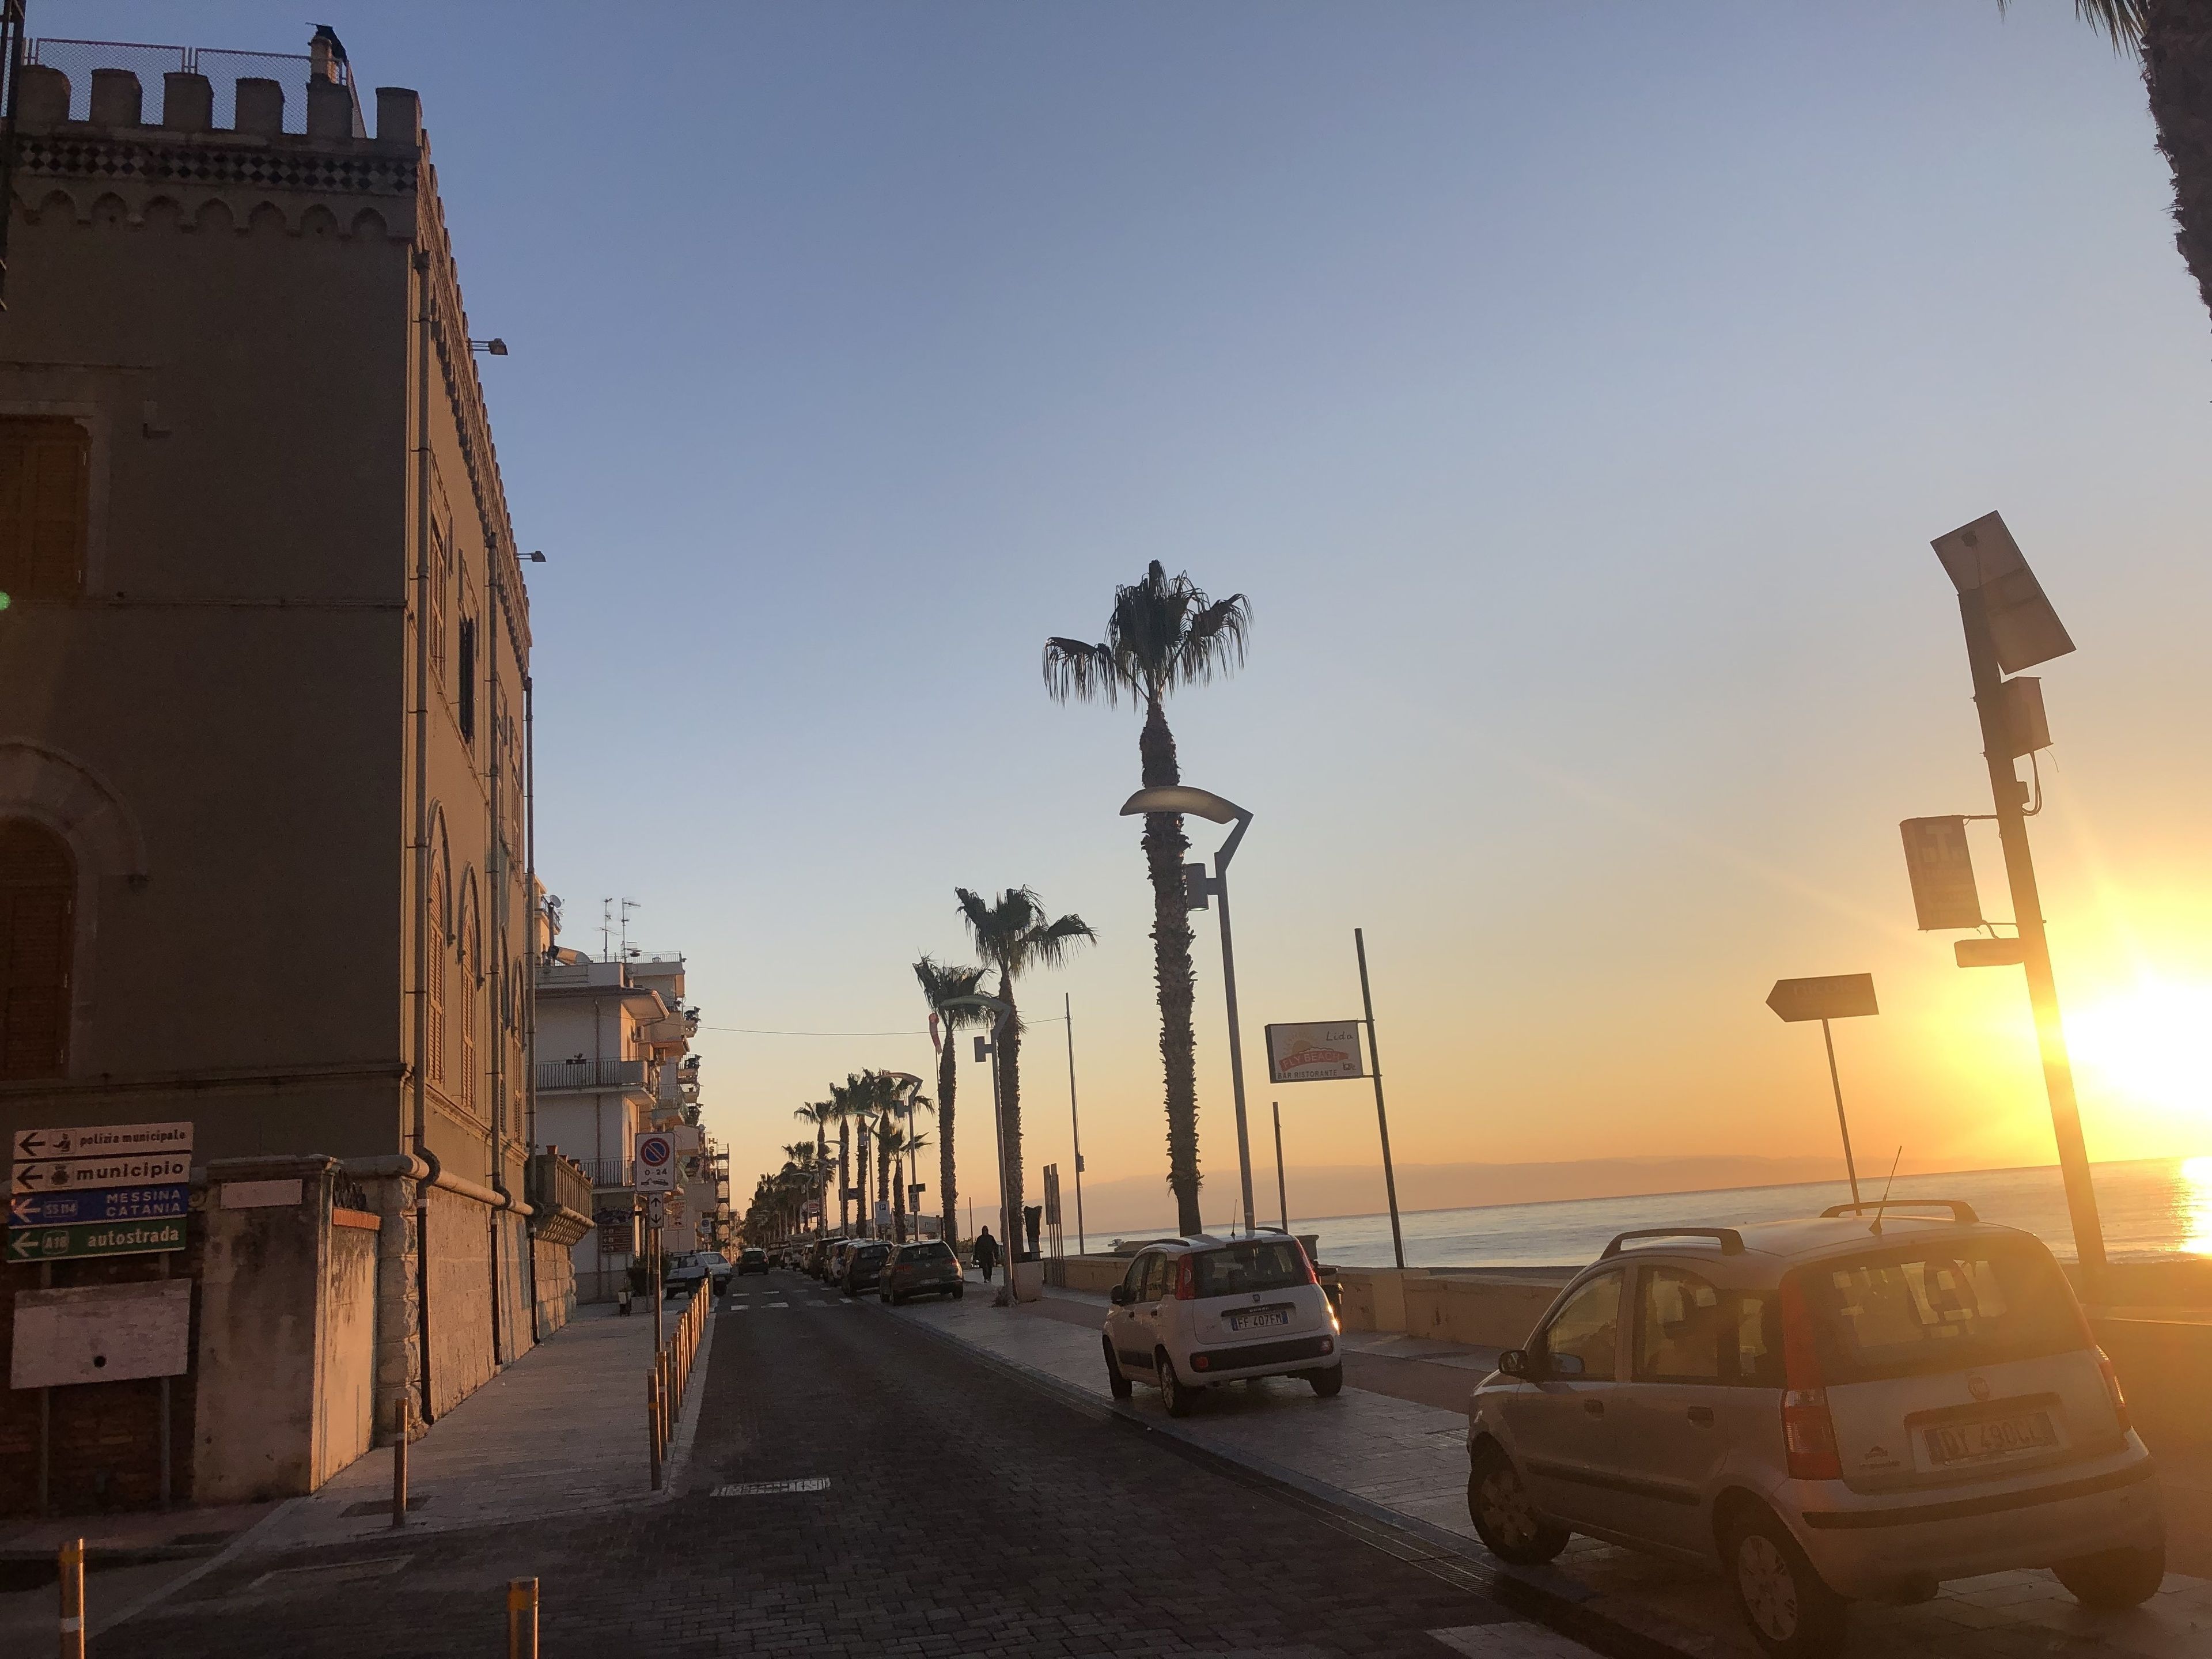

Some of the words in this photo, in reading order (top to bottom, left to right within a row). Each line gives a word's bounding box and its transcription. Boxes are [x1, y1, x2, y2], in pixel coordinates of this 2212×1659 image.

[1282, 1055, 1301, 1069] FLY
[1304, 1051, 1340, 1062] BEACH
[1278, 1071, 1292, 1080] BAR
[1294, 1069, 1338, 1078] RISTORANTE
[79, 1132, 119, 1147] polizia
[122, 1129, 185, 1143] municipale
[77, 1161, 184, 1180] municipio
[105, 1190, 181, 1204] MESSINA
[105, 1202, 181, 1217] CATANIA
[88, 1226, 179, 1248] autostrada
